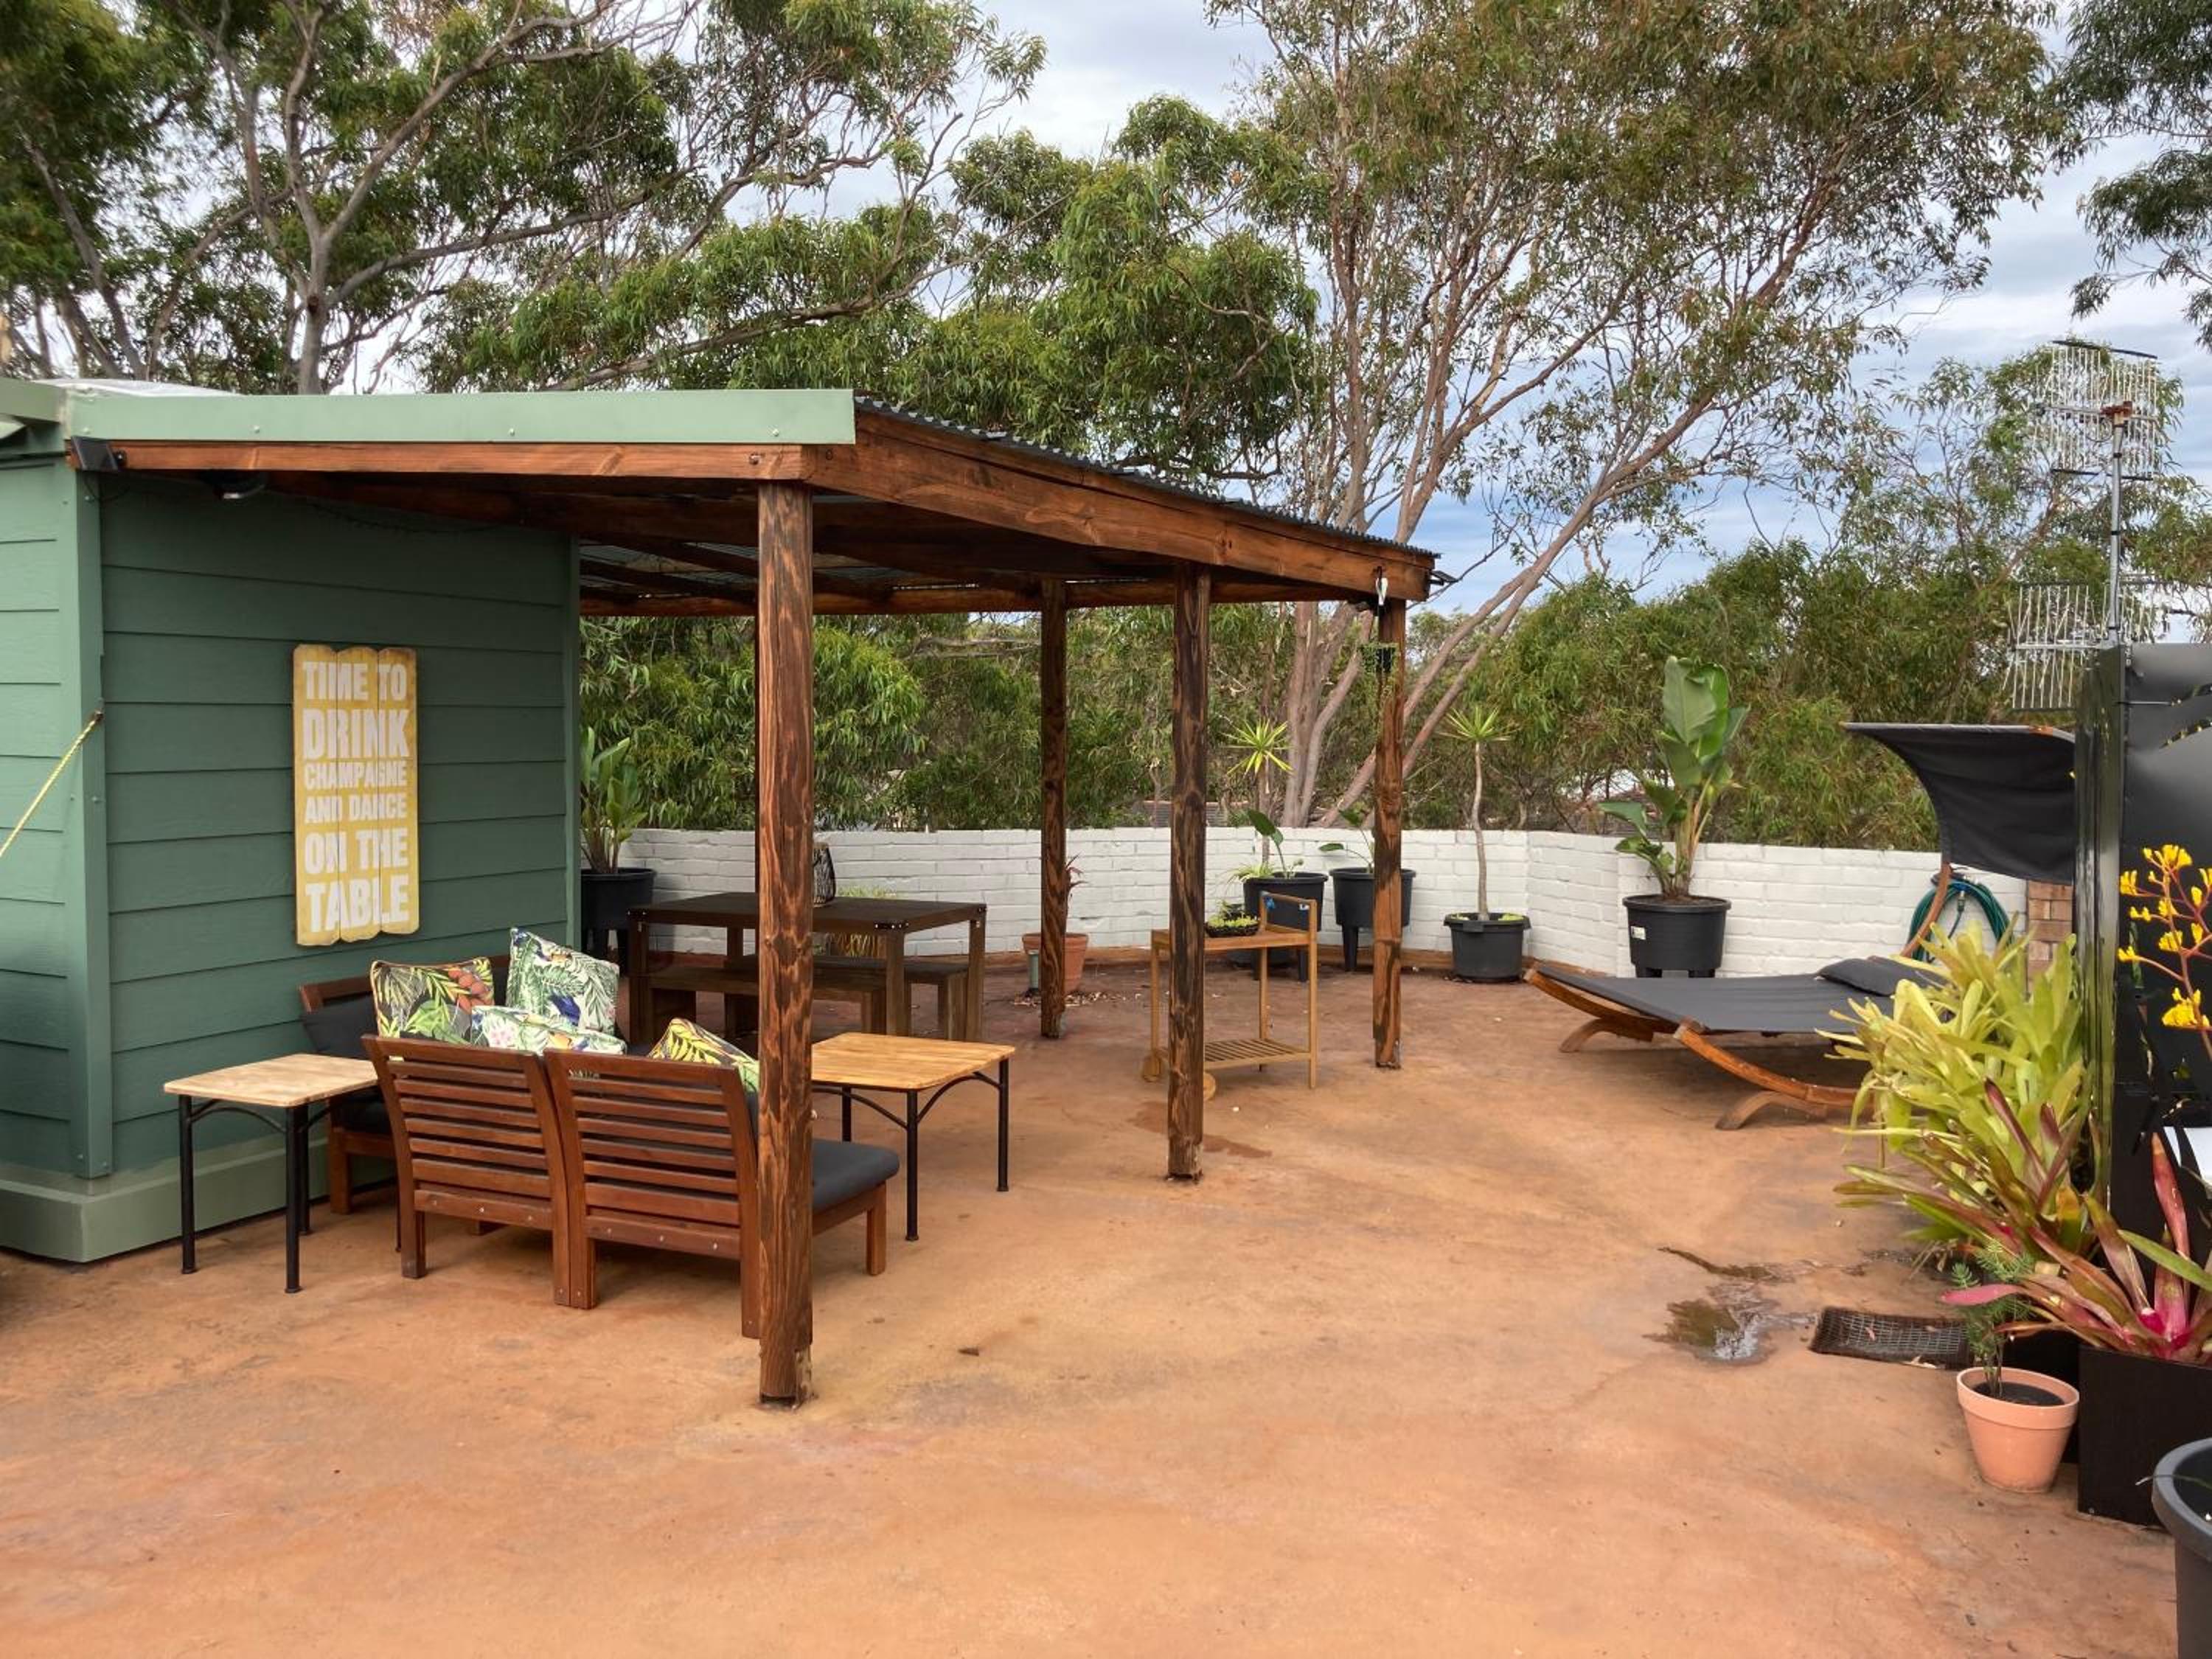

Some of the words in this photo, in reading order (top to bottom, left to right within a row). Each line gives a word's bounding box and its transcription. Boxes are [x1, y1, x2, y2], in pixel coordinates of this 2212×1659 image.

[303, 661, 369, 700] TIME
[378, 664, 407, 700] TO
[303, 708, 410, 759] DRINK
[305, 760, 407, 790] CHAMPAGNE
[305, 795, 343, 824] AND
[349, 793, 407, 821] DANCE
[305, 831, 347, 874] ON
[355, 827, 408, 870] THE
[305, 874, 409, 933] TABLE
